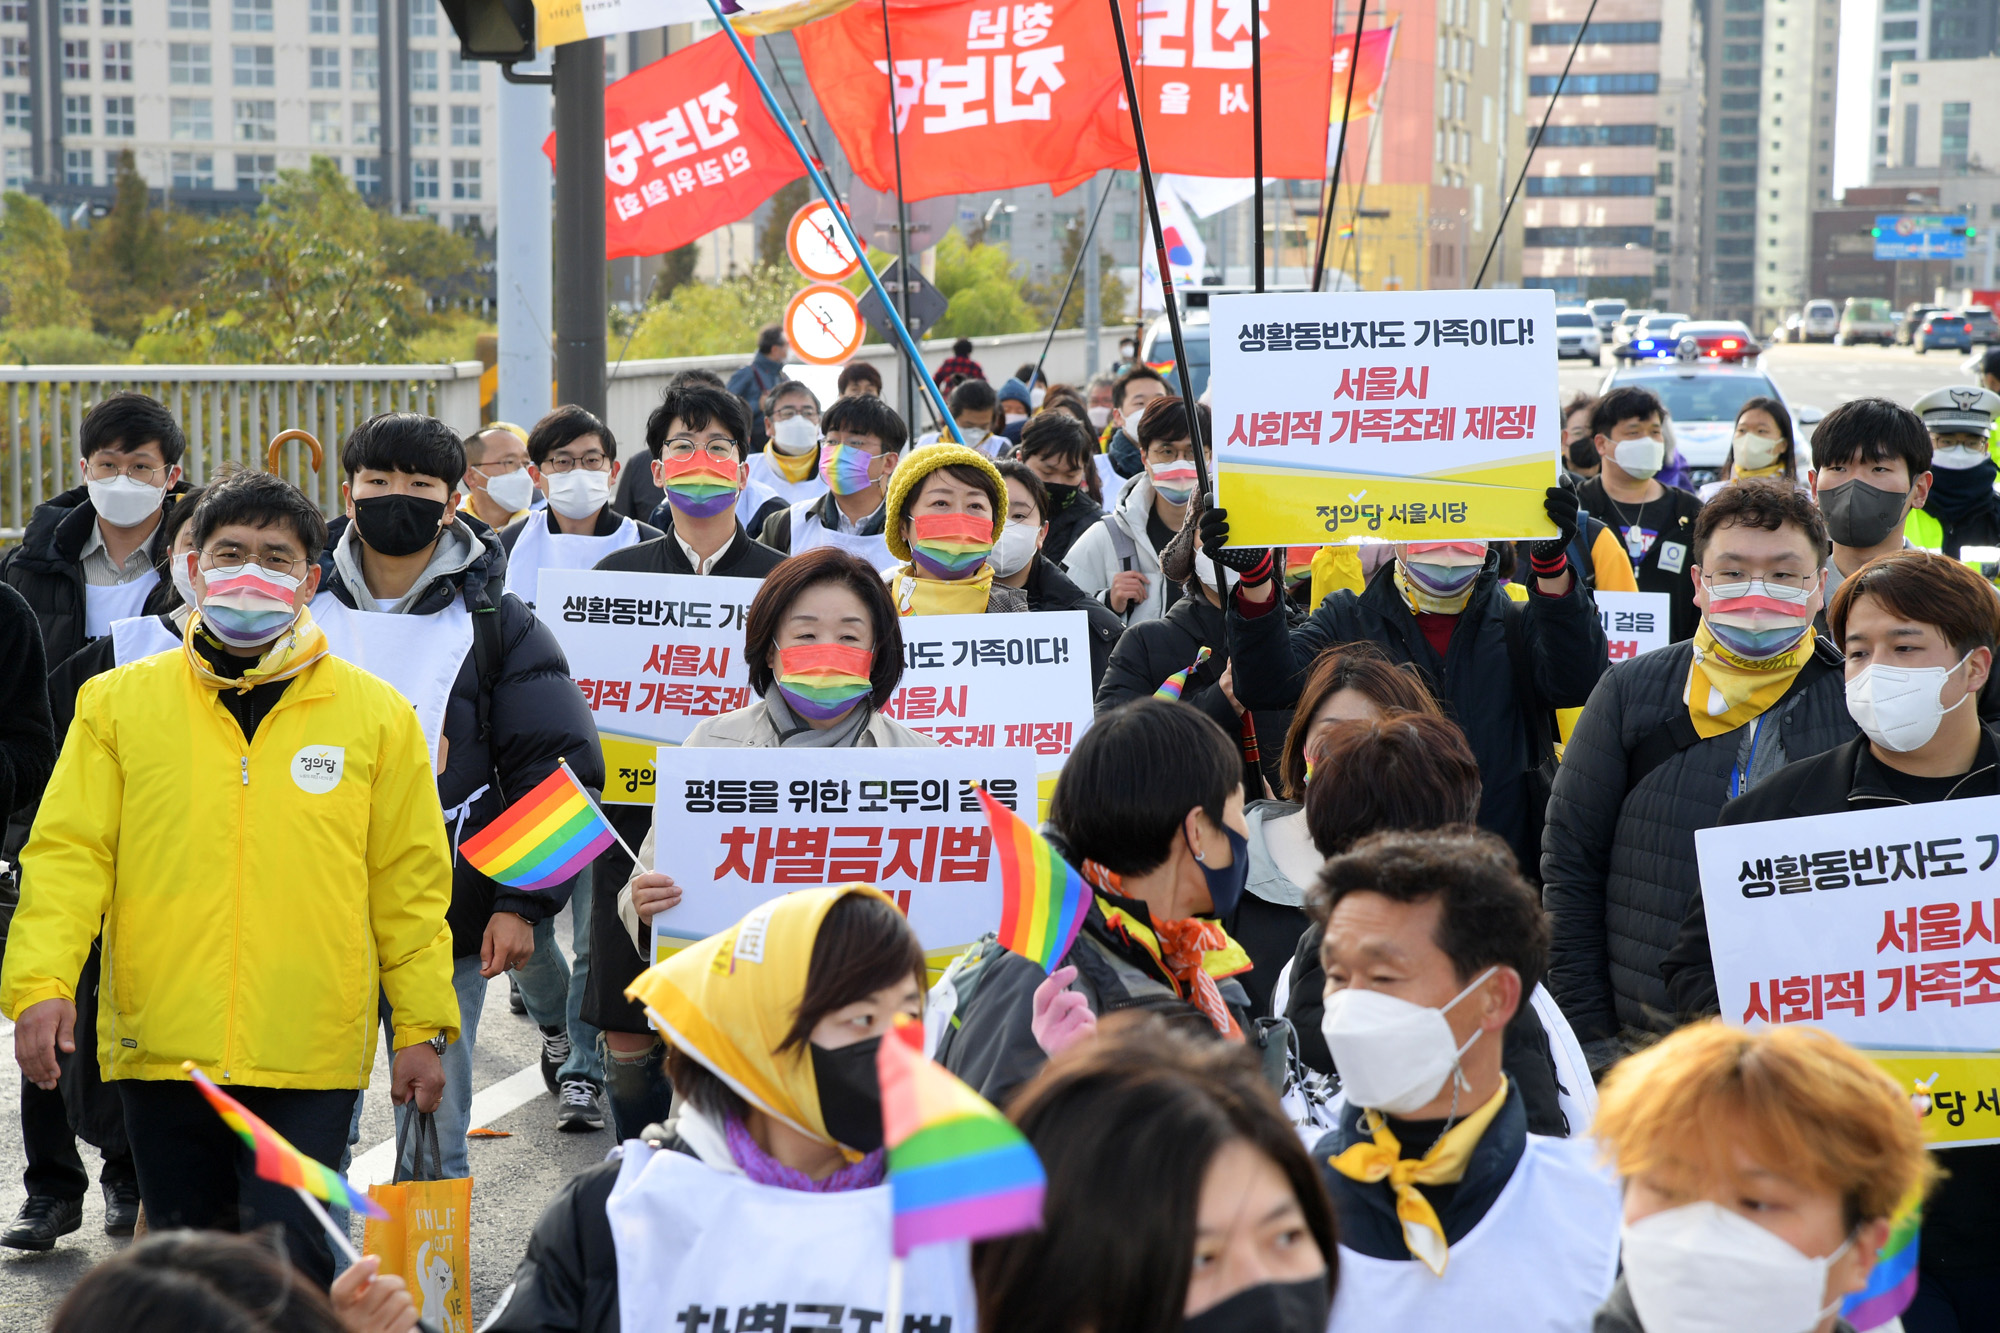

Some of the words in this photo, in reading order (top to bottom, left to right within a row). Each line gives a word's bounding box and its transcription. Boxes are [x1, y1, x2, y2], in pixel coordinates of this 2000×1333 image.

[1238, 320, 1406, 352] 생활동반자도
[1413, 318, 1535, 347] 가족이다!
[1333, 366, 1430, 402] 서울시
[1227, 410, 1323, 447] 사회적
[1328, 406, 1456, 444] 가족조례
[1463, 404, 1537, 441] 제정!
[1316, 503, 1384, 532] 정의당
[1388, 501, 1468, 525] 서울시당
[562, 595, 712, 628] 생활동반자도
[1615, 611, 1655, 633] 걸음
[642, 644, 731, 679] 서울시
[952, 636, 1069, 667] 가족이다!
[571, 678, 632, 713] 회적
[635, 682, 750, 716] 가족조례
[879, 685, 968, 720] 서울시
[1004, 722, 1073, 755] 제정!
[300, 757, 337, 773] 정의당
[684, 779, 779, 814] 평등을
[787, 778, 849, 814] 위한
[857, 778, 950, 813] 모두의
[713, 826, 994, 883] 차별금지법
[1738, 837, 1968, 899] 생활동반자도
[1876, 897, 2000, 955] 서울시
[1743, 970, 1866, 1025] 사회적
